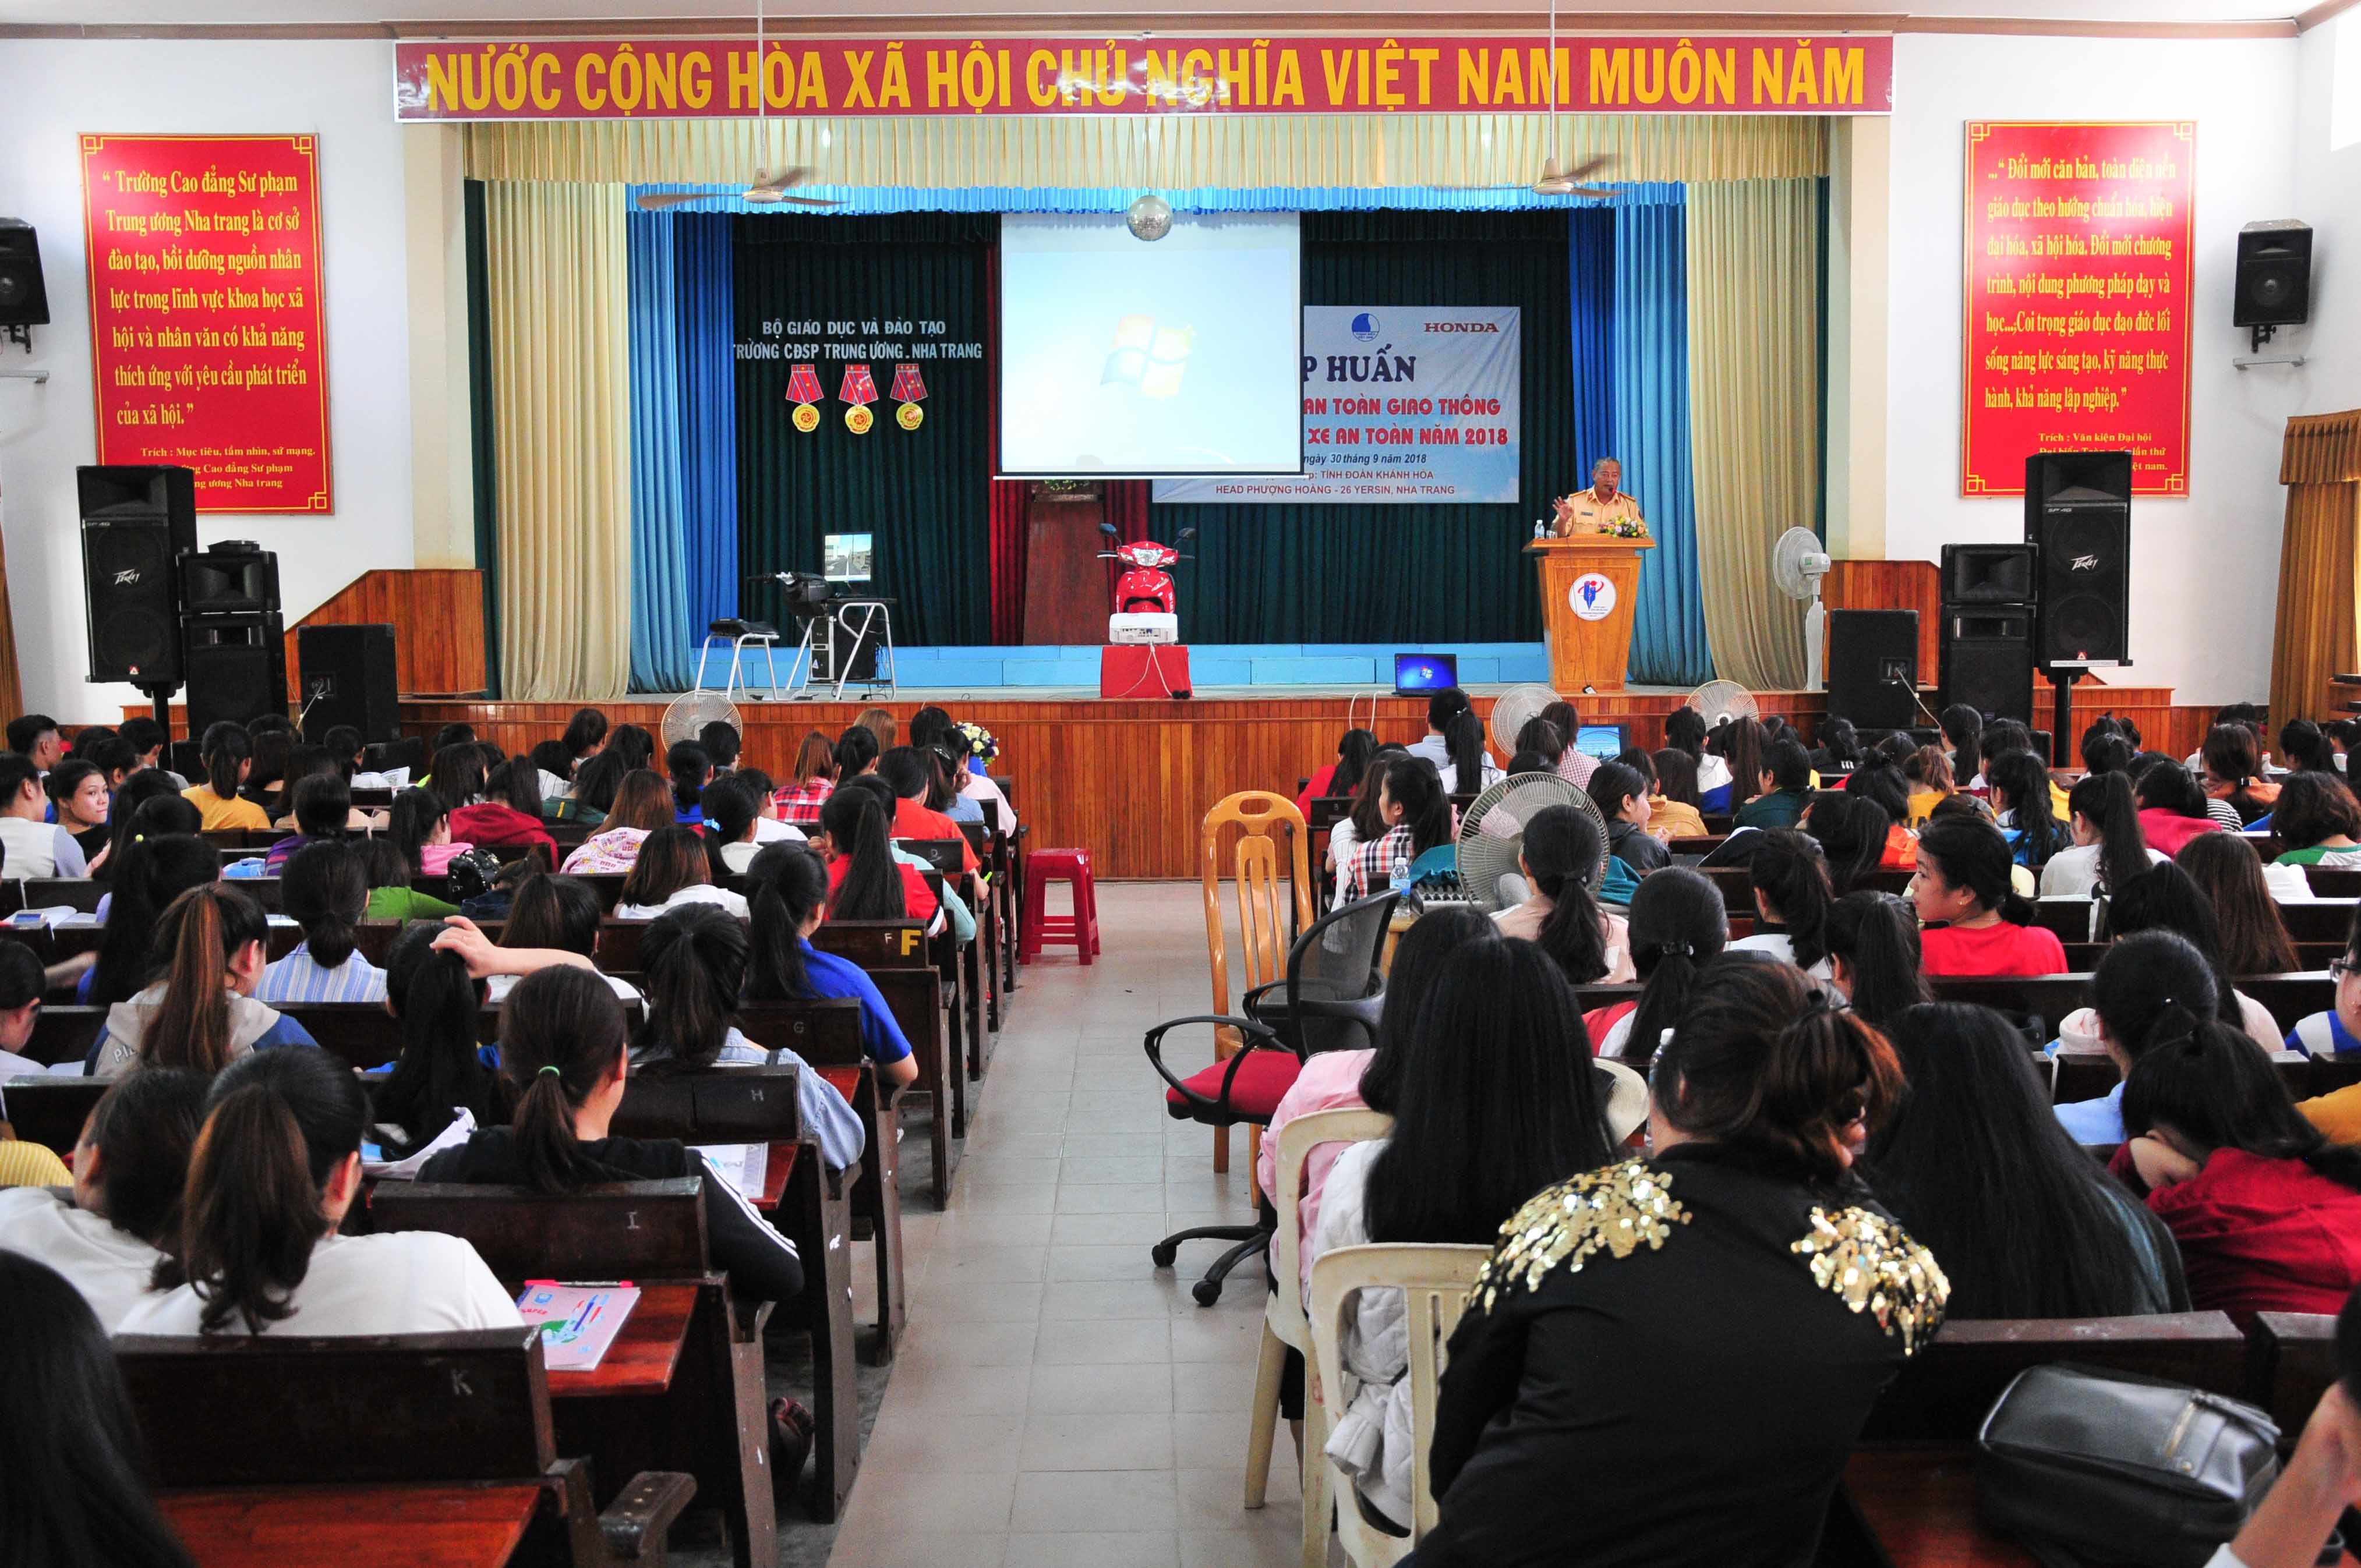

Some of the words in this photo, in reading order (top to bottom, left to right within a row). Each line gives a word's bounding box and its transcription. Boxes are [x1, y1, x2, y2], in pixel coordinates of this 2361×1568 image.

[427, 44, 561, 110] NƯỚC
[576, 44, 712, 114] CỘNG
[729, 42, 828, 108] HÒA
[844, 42, 911, 107] XÃ
[927, 41, 1010, 114] HỘI
[1027, 39, 1126, 106] CHỦ
[1147, 39, 1301, 106] NGHĨA
[1321, 39, 1439, 111] VIỆT
[1458, 48, 1570, 104] NAM
[1591, 38, 1734, 104] MUÔN
[1753, 40, 1864, 104] NĂM
[115, 170, 168, 198] Trường
[170, 171, 198, 193] Cao
[202, 165, 236, 198] đẳng
[238, 171, 257, 192] Sư
[260, 171, 298, 198] phạm
[105, 209, 147, 236] Trung
[150, 212, 182, 236] ương
[185, 210, 211, 231] Nha
[214, 213, 250, 236] trang
[252, 210, 264, 231] là
[268, 212, 283, 231] cơ
[285, 207, 299, 230] sở
[108, 249, 132, 270] đào
[135, 252, 160, 274] tạo,
[162, 244, 182, 270] bồi
[186, 249, 225, 275] dưỡng
[228, 244, 267, 275] nguồn
[270, 248, 301, 270] nhân
[1987, 272, 2016, 297] trình,
[2019, 273, 2035, 298] nội
[2038, 272, 2064, 299] dung
[2066, 272, 2105, 299] phương
[2108, 272, 2134, 299] pháp
[2136, 273, 2155, 298] dạy
[2158, 272, 2171, 293] và
[111, 288, 130, 313] lực
[133, 291, 169, 314] trong
[202, 289, 224, 312] vực
[228, 287, 259, 308] khoa
[262, 287, 284, 312] học
[289, 286, 303, 307] xã
[762, 318, 783, 338] BỘ
[787, 318, 821, 335] GIÁO
[827, 321, 855, 338] DỤC
[861, 317, 879, 334] VÀ
[885, 317, 913, 335] ĐÀO
[919, 321, 946, 337] TẠO
[1424, 323, 1500, 332] HONDA
[2037, 314, 2066, 337] trọng
[2068, 310, 2091, 337] giáo
[2093, 311, 2111, 335] dục
[2113, 311, 2133, 335] đạo
[2135, 310, 2154, 331] đức
[2157, 307, 2171, 331] lối
[113, 326, 134, 352] hội
[137, 326, 153, 348] và
[158, 326, 191, 347] nhân
[196, 328, 220, 347] văn
[224, 325, 238, 346] có
[242, 323, 267, 346] khả
[271, 327, 305, 351] năng
[733, 338, 779, 359] RƯỜNG
[784, 343, 819, 359] CĐSP
[823, 343, 867, 359] TRUNG
[870, 341, 903, 360] ƯƠNG
[912, 343, 938, 359] NHA
[939, 343, 982, 359] TRANG
[1327, 344, 1416, 382] HUẤN
[1986, 346, 2009, 375] sống
[2012, 351, 2036, 375] năng
[2038, 349, 2053, 373] lực
[2056, 348, 2080, 375] sáng
[2081, 352, 2101, 373] tạo,
[2104, 349, 2116, 374] kỹ
[2119, 351, 2144, 374] năng
[2146, 349, 2168, 373] thực
[115, 365, 146, 386] thích
[149, 364, 172, 391] ứng
[175, 364, 193, 385] với
[196, 365, 218, 391] yêu
[221, 360, 243, 385] cầu
[246, 363, 273, 391] phát
[276, 359, 307, 384] triển
[1303, 398, 1327, 415] AN
[1333, 392, 1381, 415] TOÀN
[1387, 398, 1433, 415] GIAO
[1438, 394, 1501, 415] THÔNG
[1985, 387, 2013, 411] hành,
[2016, 384, 2034, 407] khả
[2037, 389, 2062, 412] năng
[2065, 387, 2080, 413] lập
[2083, 387, 2119, 412] nghiệp.
[117, 401, 139, 424] của
[143, 404, 157, 424] xã
[161, 403, 184, 429] hội.
[1308, 428, 1330, 445] XE
[1336, 428, 1359, 445] AN
[1366, 423, 1413, 445] TOÀN
[1419, 423, 1459, 445] NĂM
[1465, 428, 1508, 445] 2018
[2039, 433, 2064, 441] Trích
[2073, 433, 2091, 441] Văn
[2095, 433, 2115, 443] kiện
[2118, 433, 2134, 443] Đại
[2137, 433, 2152, 443] hội
[140, 447, 167, 456] Trích
[176, 448, 197, 458] Mục
[1303, 454, 1326, 465] ngày
[1330, 454, 1341, 463] 30
[1344, 454, 1370, 465] tháng
[1373, 454, 1379, 463] 9
[1381, 454, 1401, 463] năm
[1404, 454, 1426, 463] 2018
[2150, 447, 2166, 455] thứ
[203, 463, 222, 473] Cao
[225, 461, 249, 475] đẳng
[252, 463, 264, 473] Sư
[266, 463, 292, 475] phạm
[1345, 469, 1373, 479] ĐOÀN
[1376, 469, 1410, 479] KHÁNH
[208, 479, 232, 489] ương
[235, 479, 253, 487] Nha
[257, 479, 282, 489] trang
[1216, 486, 1243, 494] HEAD
[1247, 484, 1292, 496] PHƯỢNG
[1295, 483, 1331, 494] HOÀNG
[1341, 486, 1351, 494] 26
[1355, 486, 1393, 495] YERSIN,
[1397, 486, 1417, 494] NHA
[1420, 486, 1455, 494] TRANG
[901, 929, 922, 955] F
[751, 1089, 764, 1102] H
[452, 1369, 472, 1396] K
